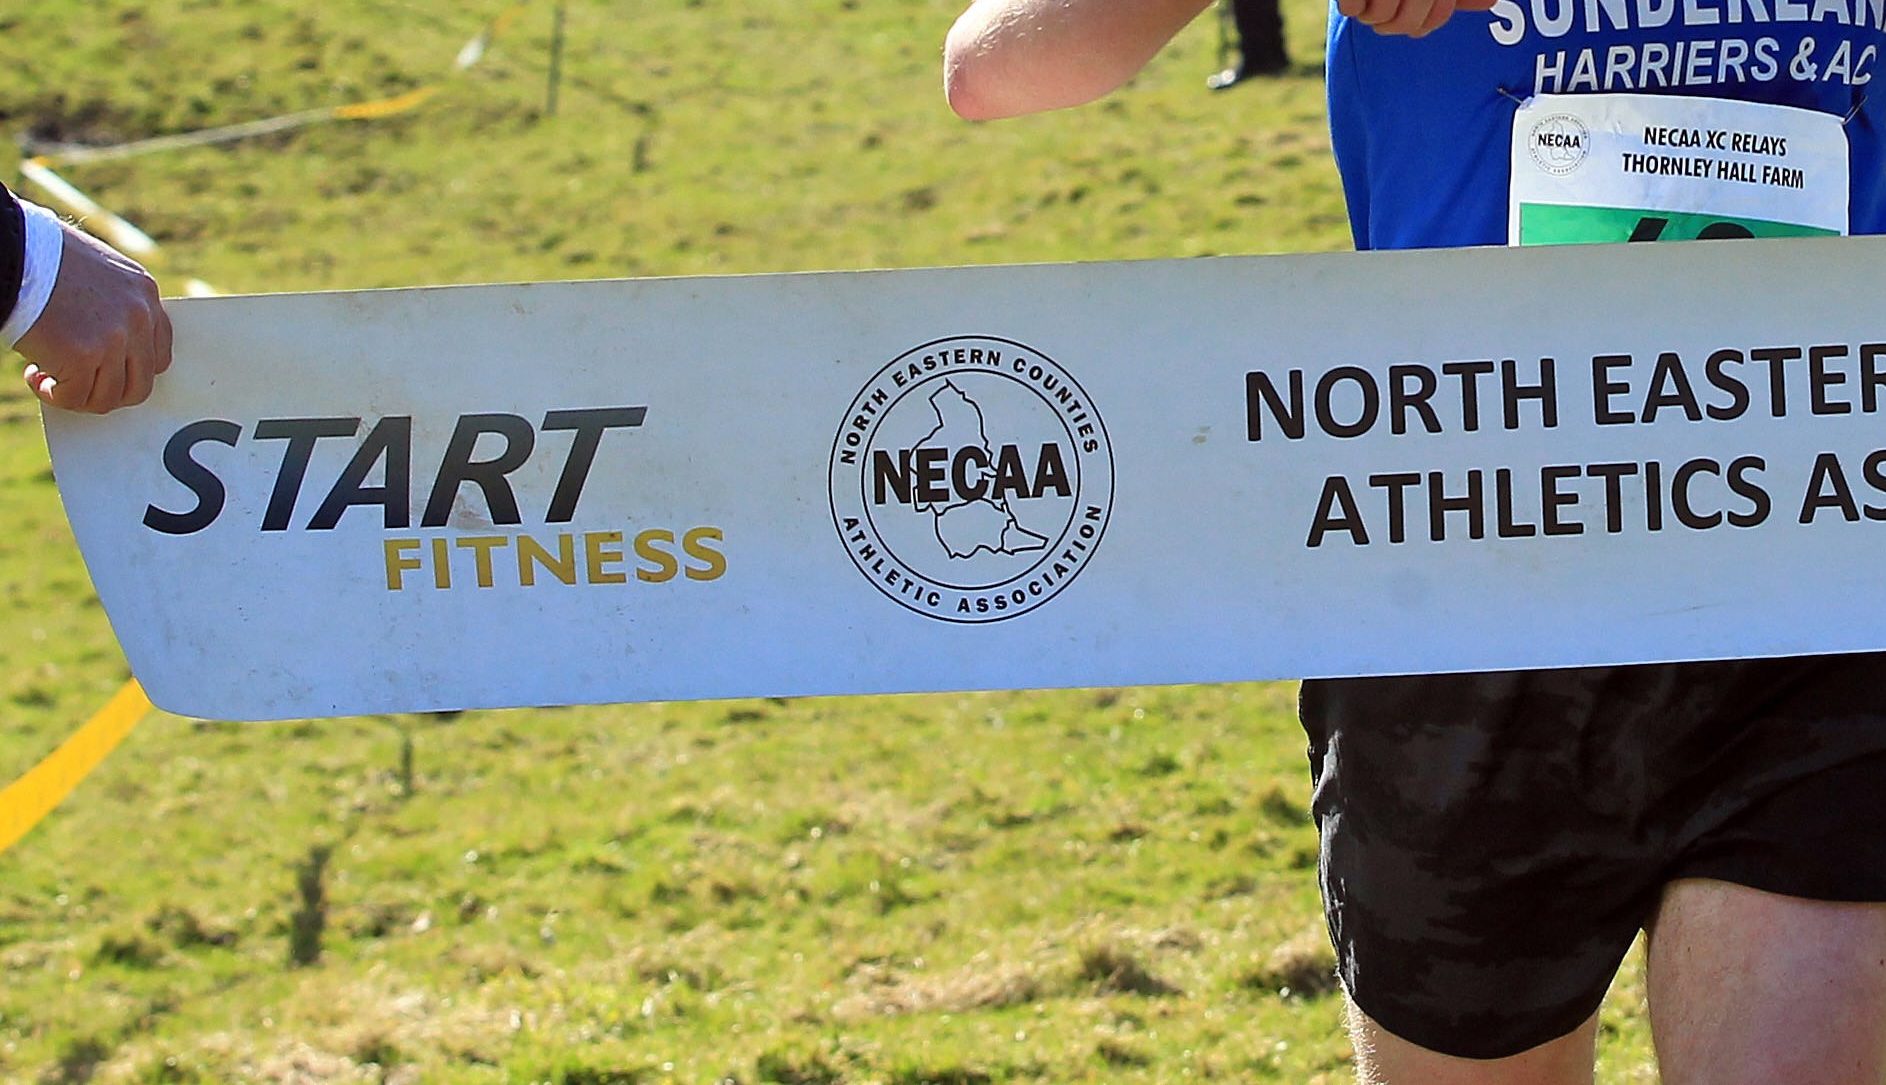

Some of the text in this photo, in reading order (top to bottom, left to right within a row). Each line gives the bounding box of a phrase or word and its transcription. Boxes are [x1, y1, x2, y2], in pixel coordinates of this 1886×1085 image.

[1534, 36, 1877, 94] HARRIERS & AC
[1538, 133, 1581, 149] NECAA
[1622, 153, 1805, 190] THORNLEY HALL FARM
[1643, 127, 1787, 156] NECAA XC RELAYS
[841, 348, 1099, 465] NORTH EASTERN COUNTIES
[1245, 358, 1558, 441] NORTH
[142, 406, 648, 535] START
[873, 443, 1072, 505] NECAA
[1306, 456, 1771, 547] ATHLETICS
[383, 527, 728, 590] FITNESS
[843, 505, 1102, 613] ATHLETIC ASSOCIATION
